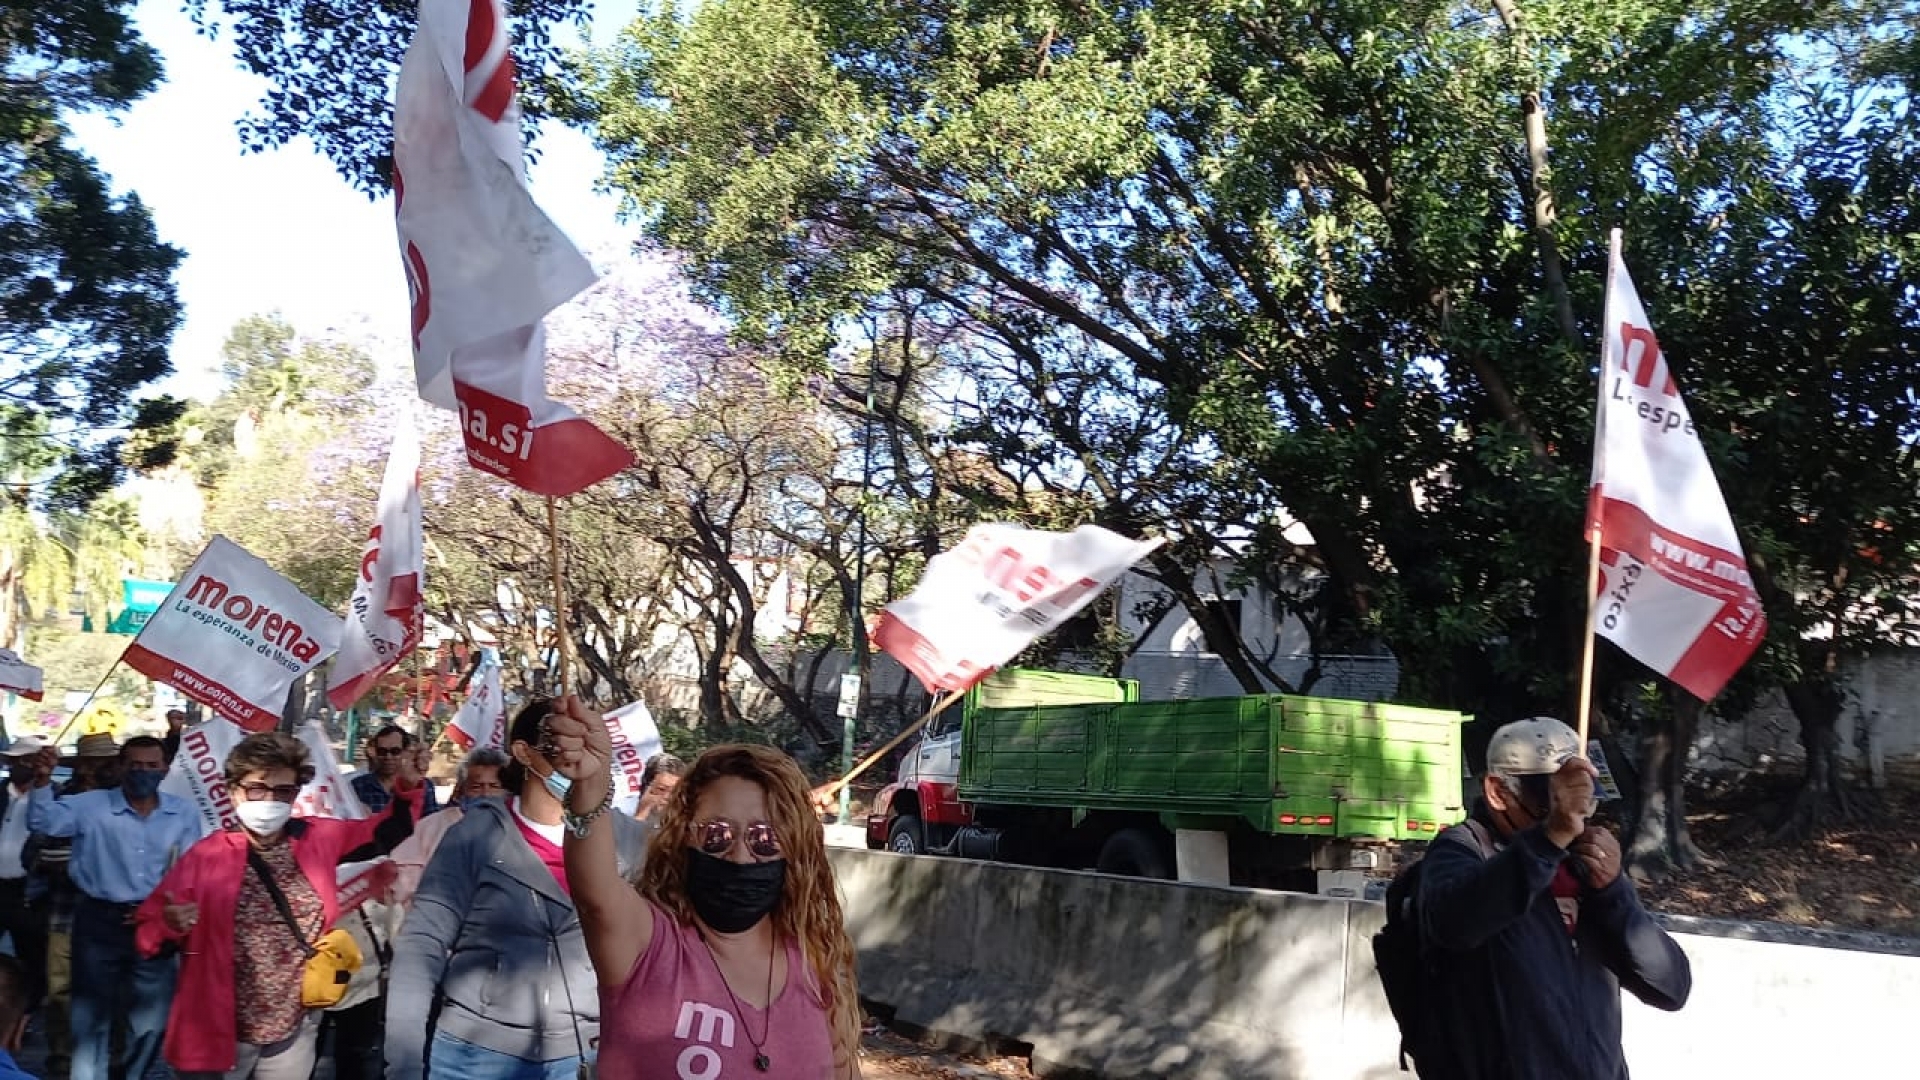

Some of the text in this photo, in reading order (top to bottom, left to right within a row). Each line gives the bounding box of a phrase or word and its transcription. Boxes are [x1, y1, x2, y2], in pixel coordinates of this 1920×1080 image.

[175, 599, 190, 614] La
[192, 608, 255, 648] esperanza
[256, 642, 272, 658] de
[185, 574, 321, 664] morena
